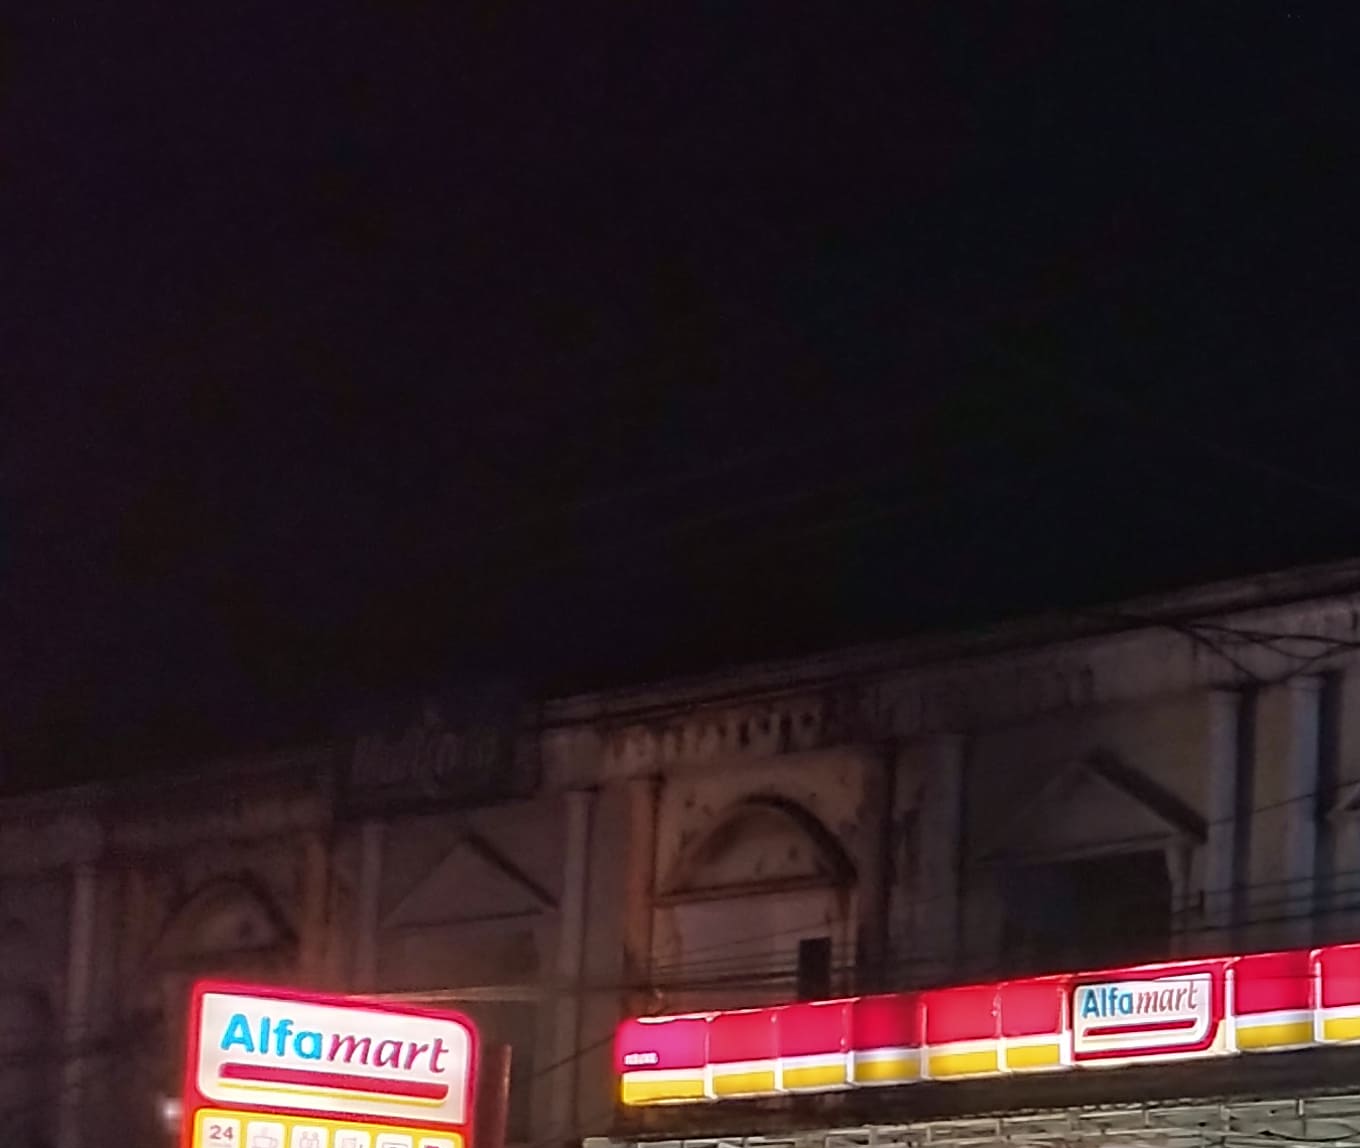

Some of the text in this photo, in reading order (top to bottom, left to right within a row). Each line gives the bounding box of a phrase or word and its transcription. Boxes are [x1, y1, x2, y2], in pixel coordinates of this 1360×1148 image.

[1082, 980, 1198, 1019] Alfamart
[220, 1013, 449, 1073] Alfamart
[210, 1124, 234, 1140] 24
